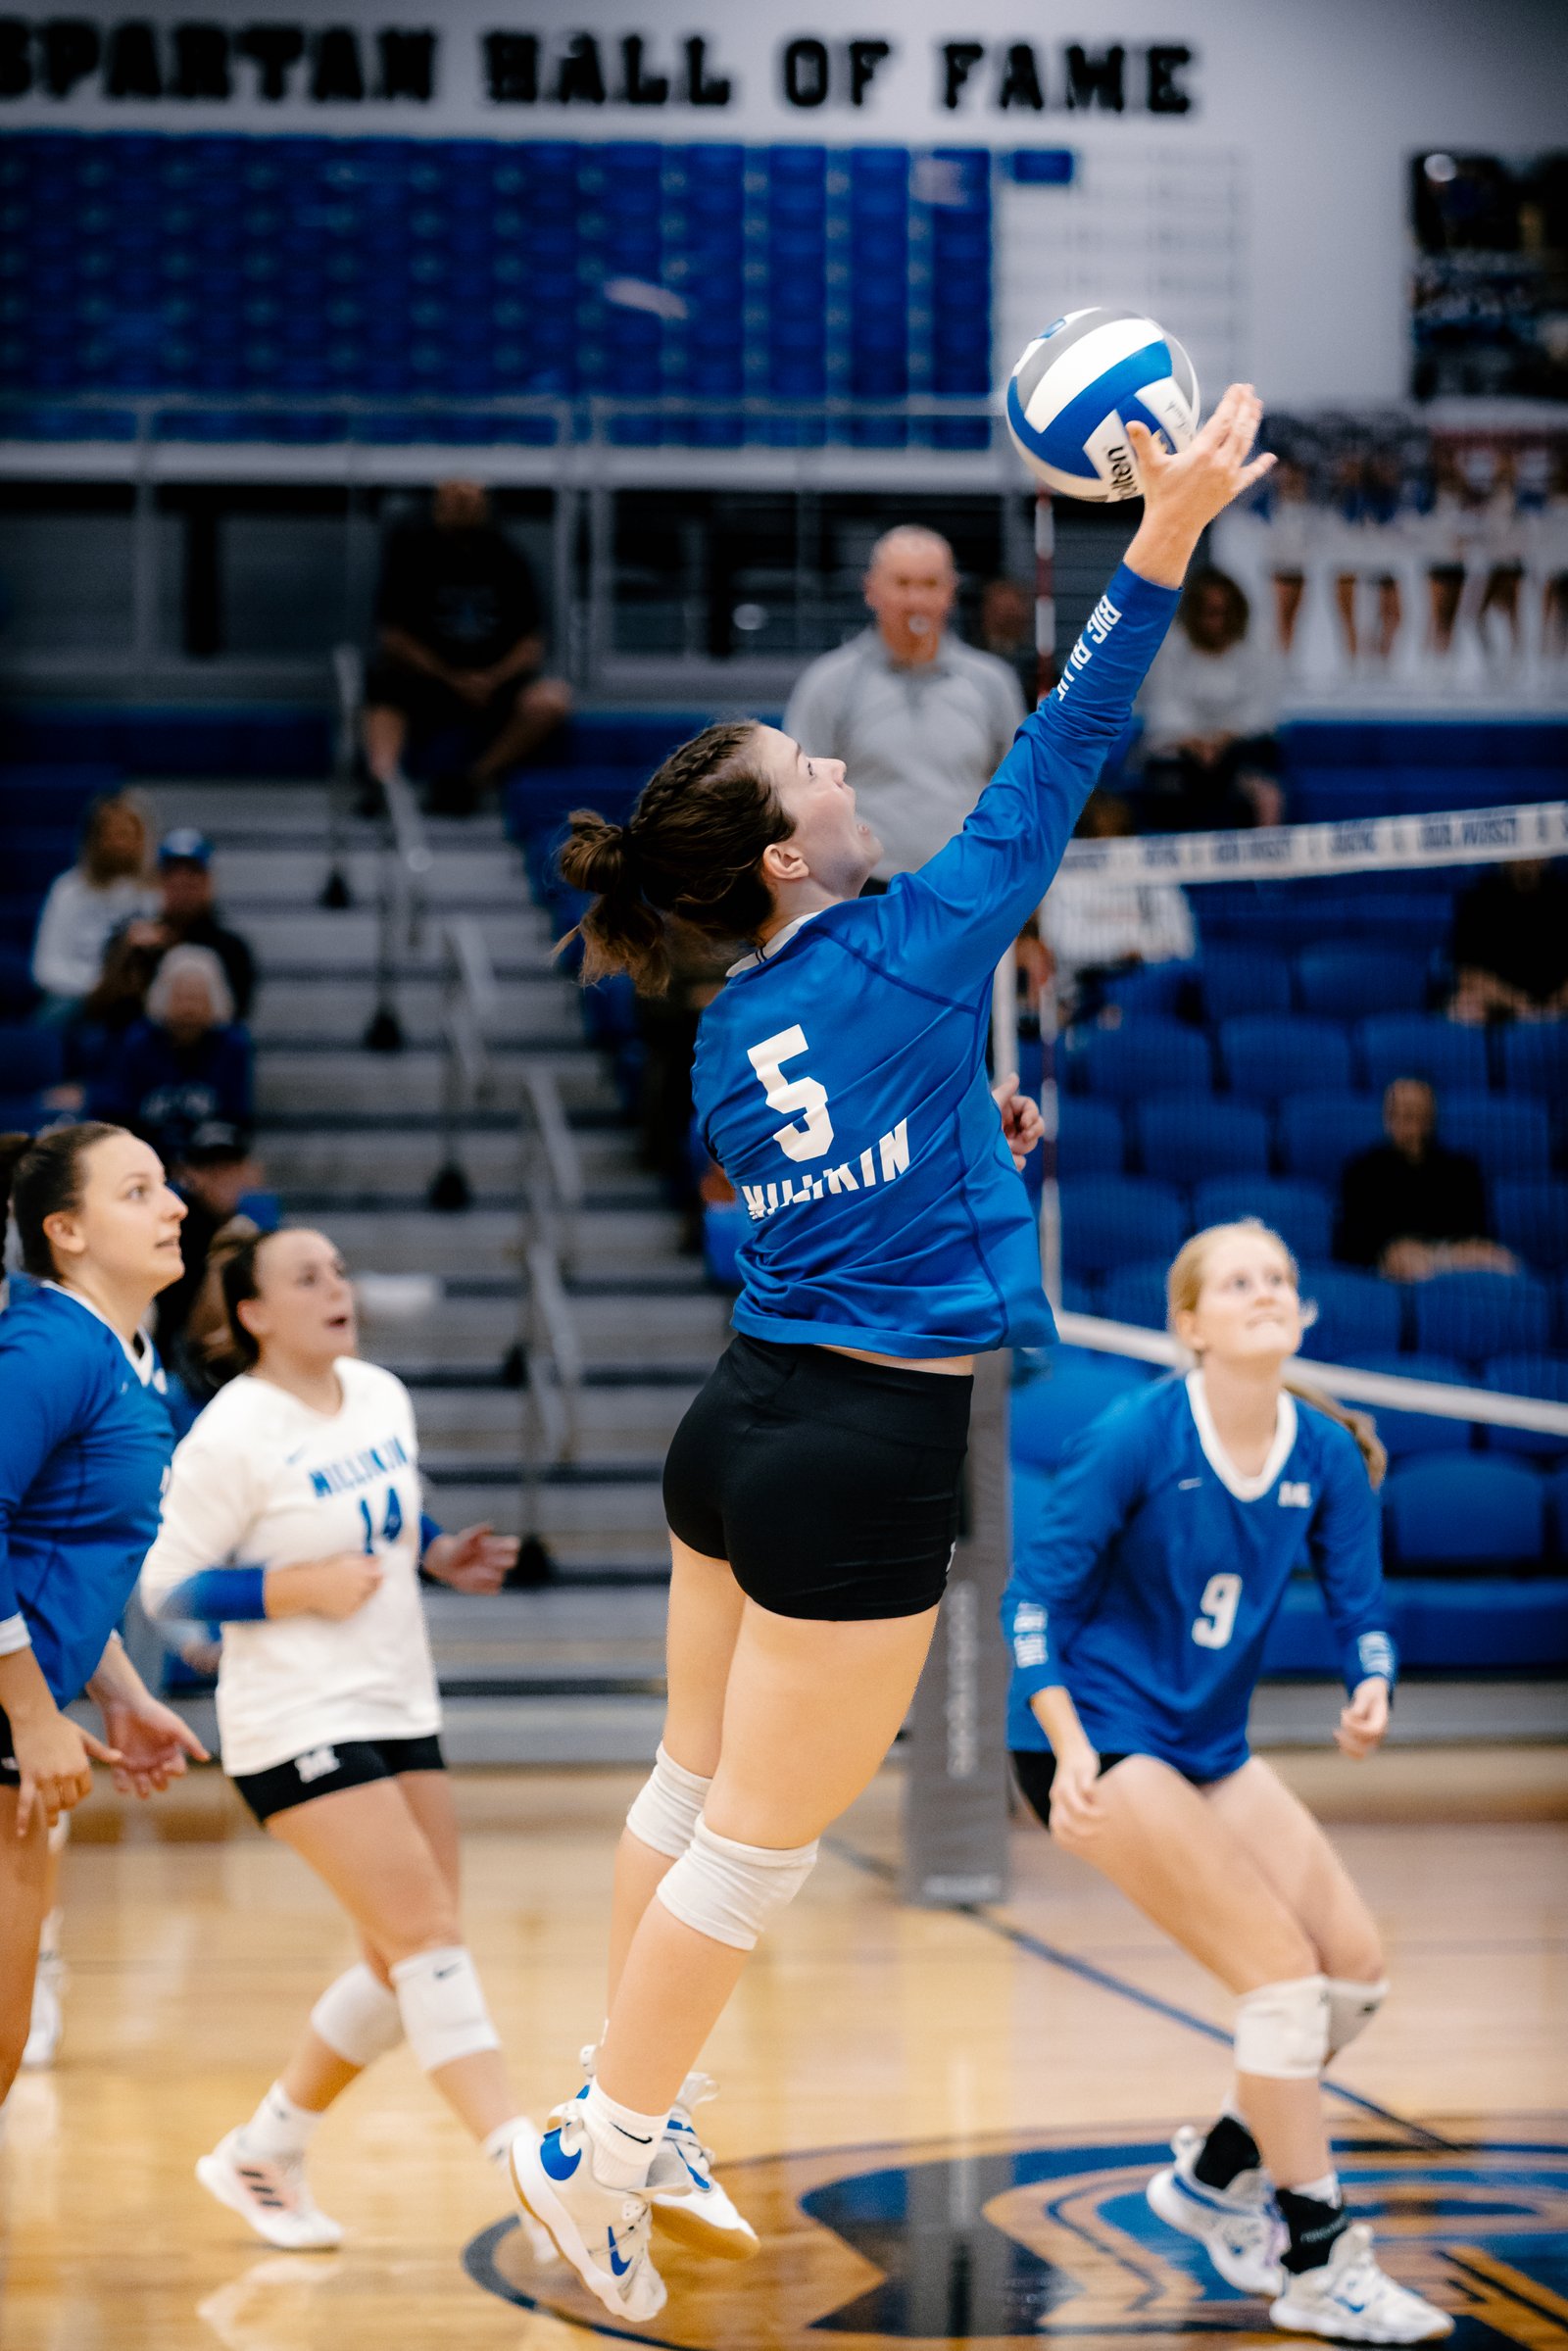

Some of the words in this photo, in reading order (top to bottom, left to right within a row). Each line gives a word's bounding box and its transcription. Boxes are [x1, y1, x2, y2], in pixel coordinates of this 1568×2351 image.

[0, 20, 438, 102] SPARTAN
[480, 31, 731, 106] HALL
[783, 38, 891, 107] OF
[943, 42, 1193, 114] FAME
[1107, 446, 1138, 500] olten
[1087, 594, 1123, 644] BIG
[746, 1023, 835, 1163] 5
[359, 1486, 404, 1555] 14
[1191, 1572, 1244, 1651] 9
